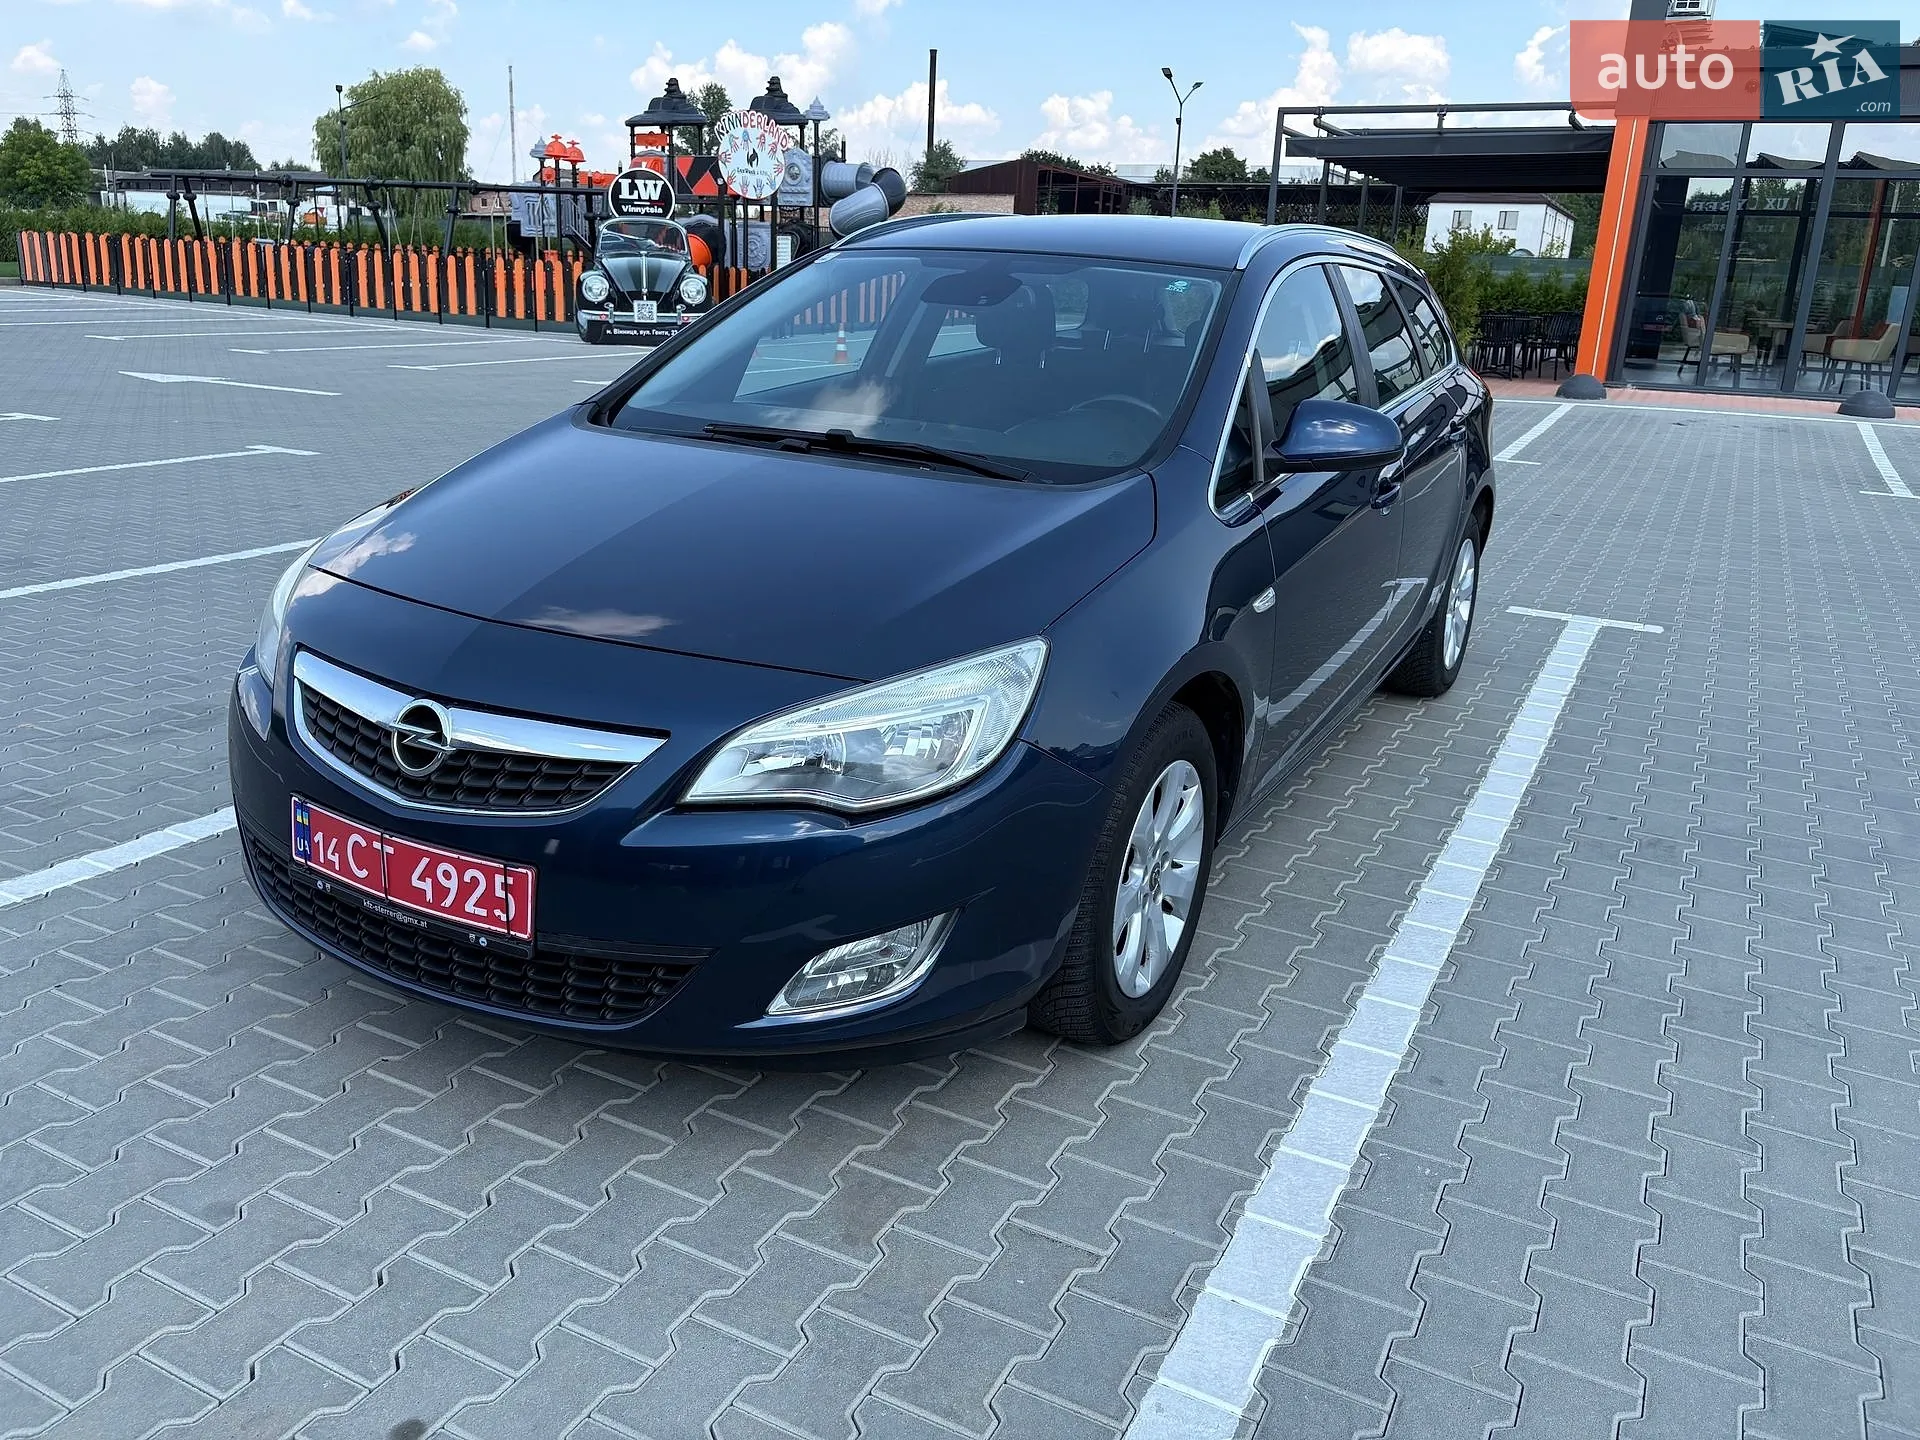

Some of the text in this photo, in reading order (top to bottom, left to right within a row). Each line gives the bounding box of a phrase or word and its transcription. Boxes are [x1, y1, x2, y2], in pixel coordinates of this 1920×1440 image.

[714, 110, 788, 150] KINNDERLAND
[618, 178, 665, 200] LW
[296, 837, 310, 855] UA
[411, 856, 516, 923] 4925
